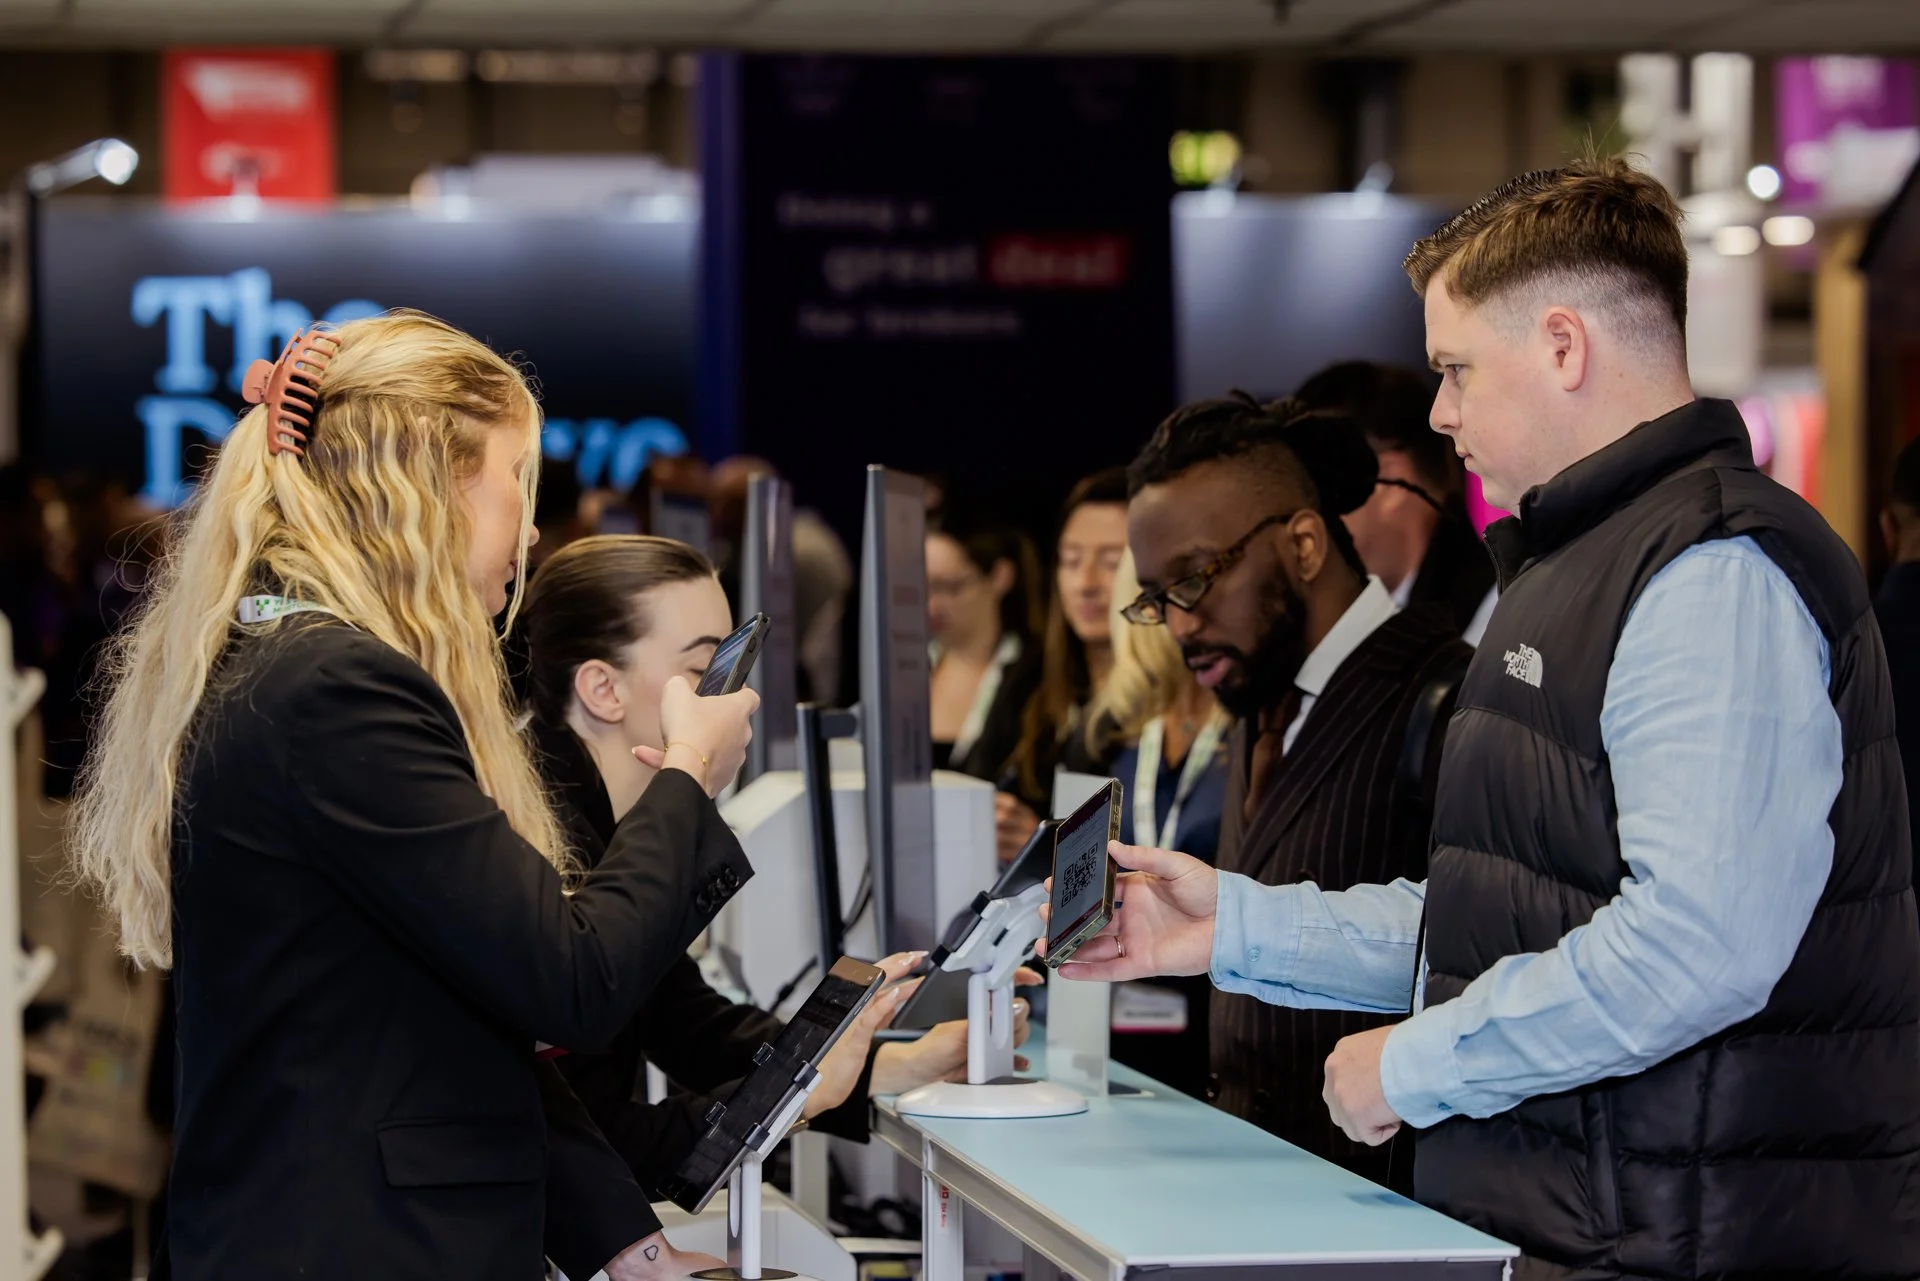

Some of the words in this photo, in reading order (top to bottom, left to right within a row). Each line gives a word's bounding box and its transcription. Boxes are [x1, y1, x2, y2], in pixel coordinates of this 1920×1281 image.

[825, 243, 976, 292] great
[993, 238, 1120, 284] deal
[130, 266, 388, 394] Th
[1503, 649, 1529, 669] NORTH
[1518, 643, 1534, 661] THE
[1505, 663, 1527, 681] FACE
